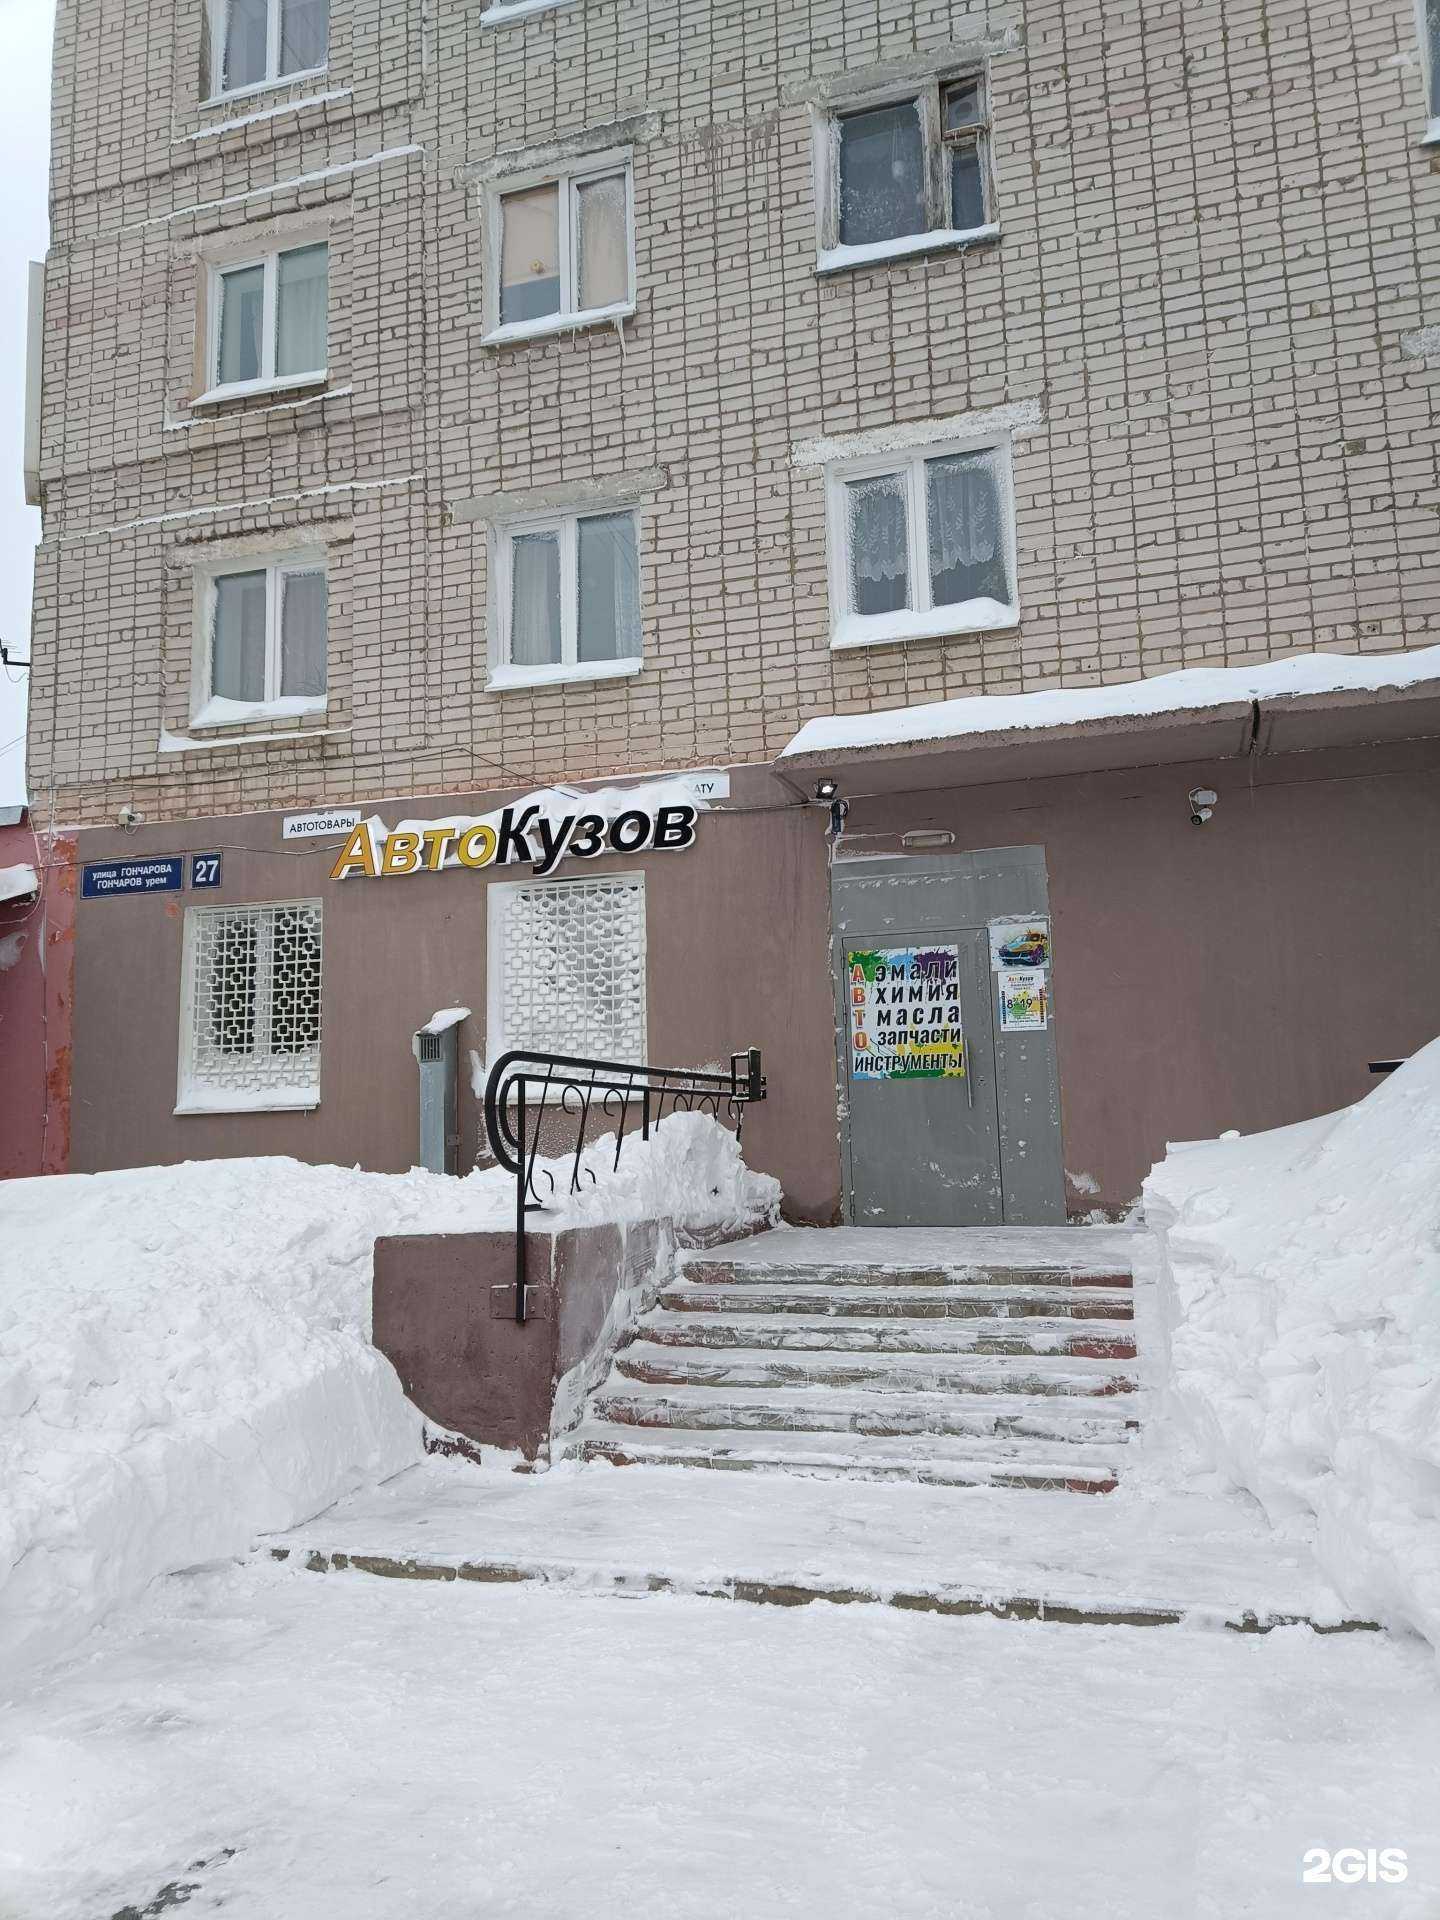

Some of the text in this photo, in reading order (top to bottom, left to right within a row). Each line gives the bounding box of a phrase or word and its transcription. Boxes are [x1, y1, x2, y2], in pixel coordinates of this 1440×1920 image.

[289, 817, 356, 833] АВТОТОВАРЫ
[92, 864, 172, 881] улица ГОНЧАРОВА
[195, 860, 219, 883] 27
[97, 876, 167, 889] ГОНЧАРОВ урем
[851, 964, 868, 1051] АВТО
